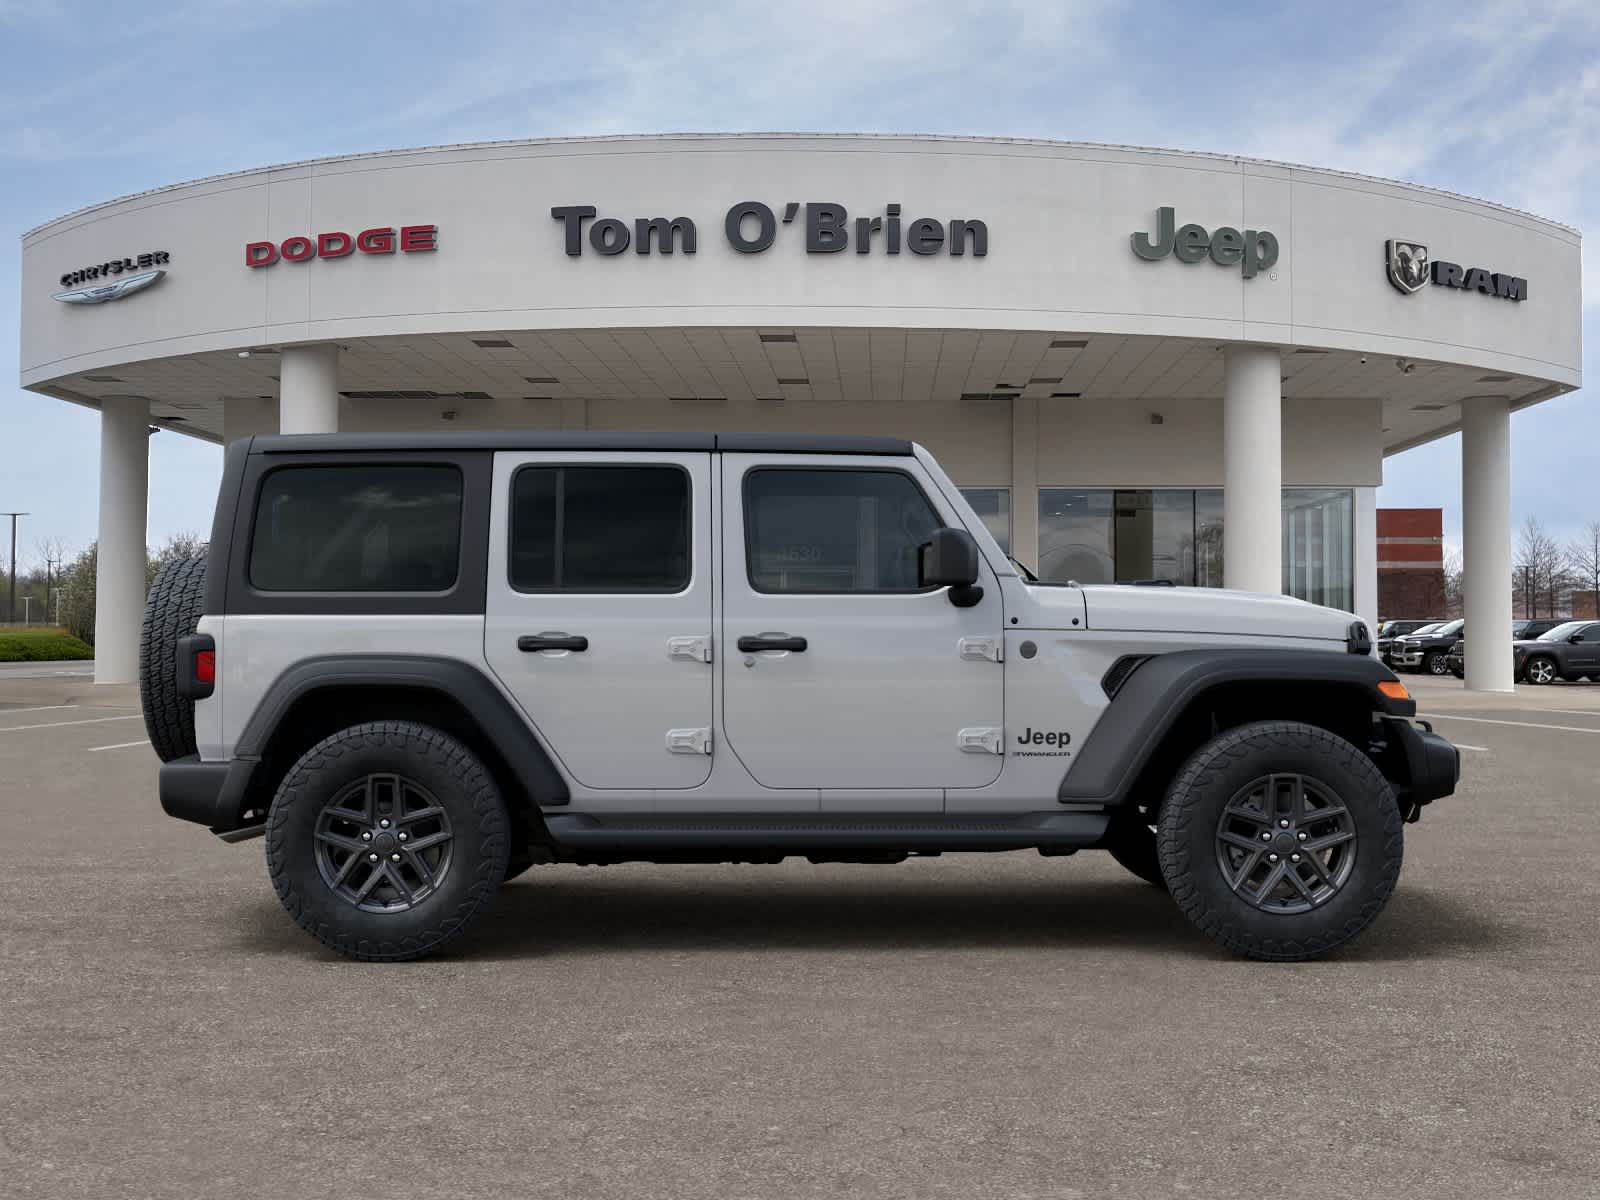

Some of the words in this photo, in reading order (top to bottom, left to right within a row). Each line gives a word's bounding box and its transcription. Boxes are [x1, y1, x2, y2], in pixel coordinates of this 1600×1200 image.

[245, 224, 438, 268] DODGE
[551, 204, 697, 256] Tom
[725, 200, 988, 257] O'Brien
[1130, 206, 1280, 280] Jeep
[60, 250, 170, 287] CHRYSLER
[1430, 260, 1528, 301] RAM
[1017, 727, 1071, 749] Jeep
